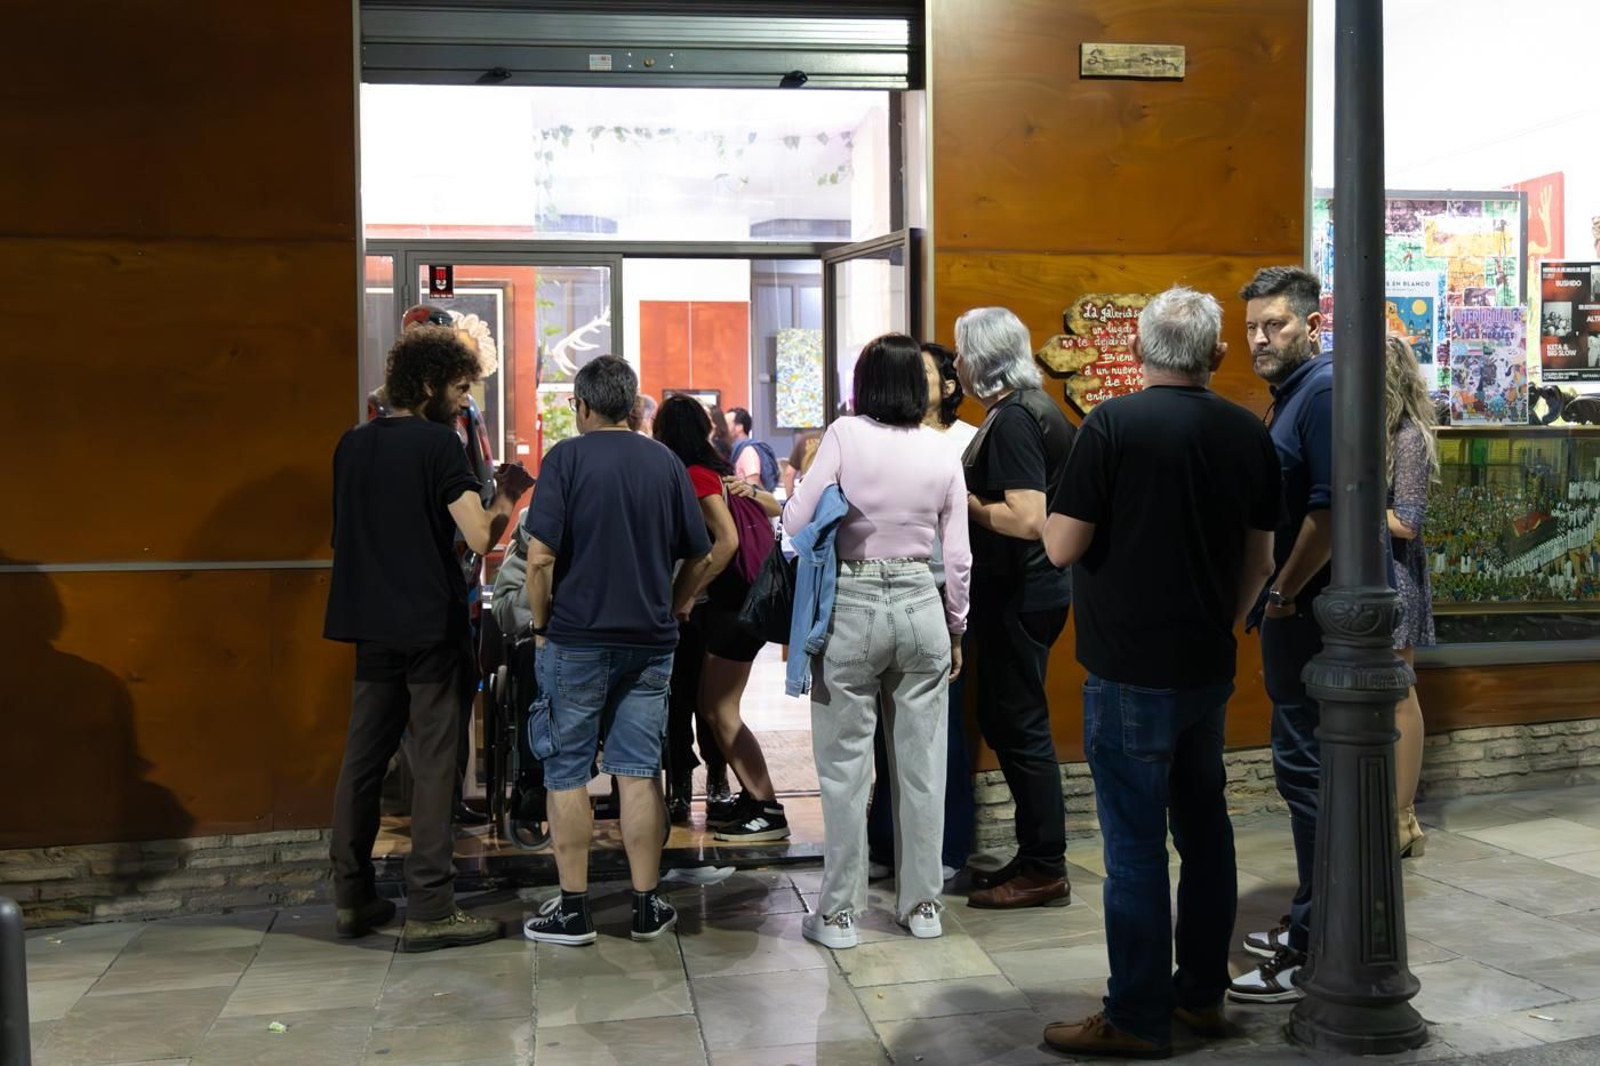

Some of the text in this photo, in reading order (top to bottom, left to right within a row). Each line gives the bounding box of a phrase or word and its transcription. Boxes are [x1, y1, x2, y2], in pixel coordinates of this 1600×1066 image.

[1083, 302, 1098, 318] La
[1092, 326, 1105, 335] un
[1062, 339, 1073, 348] no
[1077, 337, 1089, 347] te
[1096, 353, 1134, 364] Bien
[1084, 365, 1093, 376] a
[1096, 367, 1109, 376] un
[1111, 367, 1137, 375] nuevo
